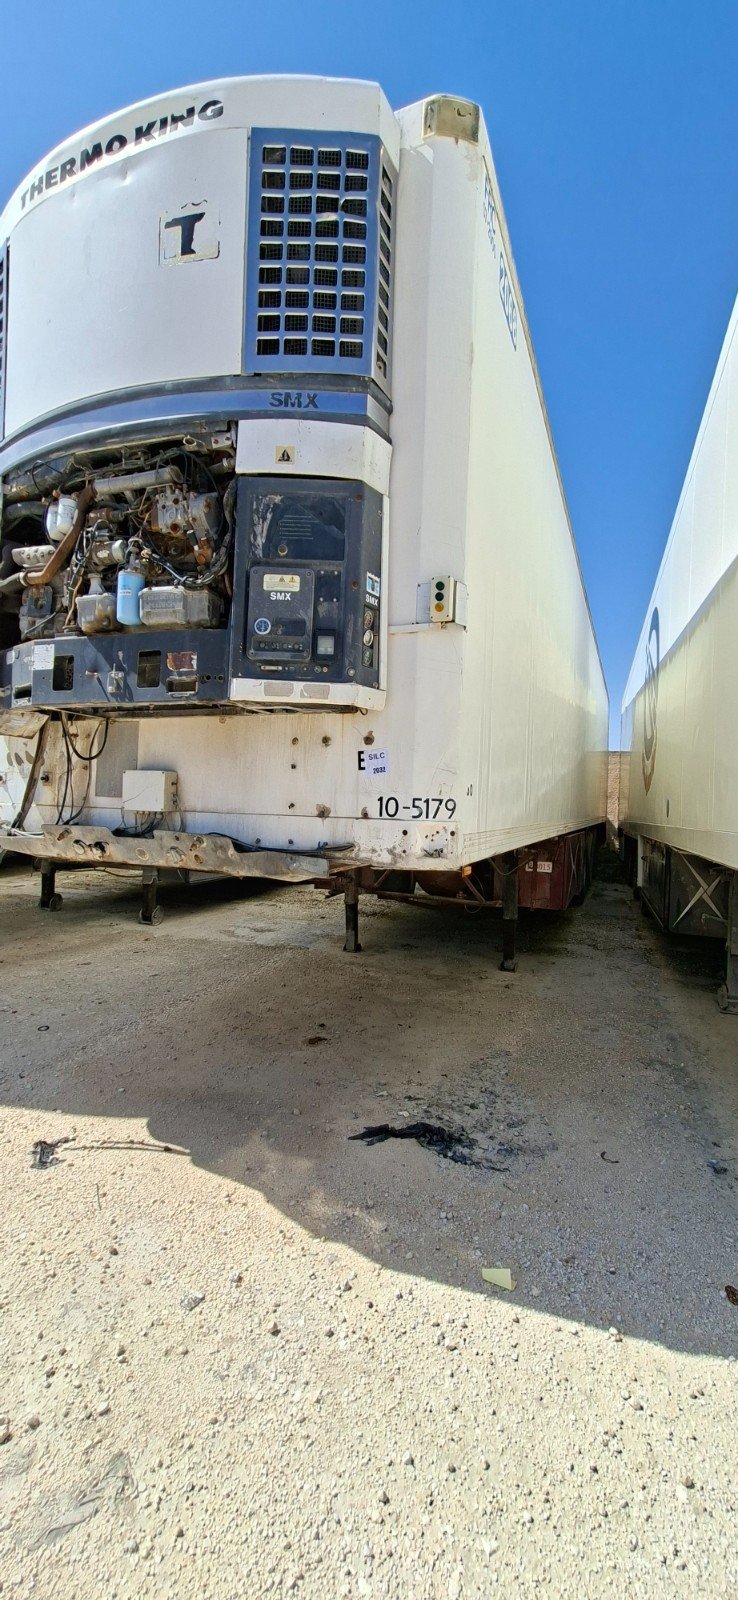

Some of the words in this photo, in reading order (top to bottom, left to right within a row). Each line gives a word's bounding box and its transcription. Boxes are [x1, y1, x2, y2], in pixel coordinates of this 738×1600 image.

[20, 134, 128, 211] THERMO
[134, 99, 224, 147] KING
[269, 391, 319, 409] SMX
[270, 591, 292, 601] SMX
[365, 593, 379, 606] SMX
[368, 752, 386, 760] SILC
[377, 796, 457, 819] 10-5179
